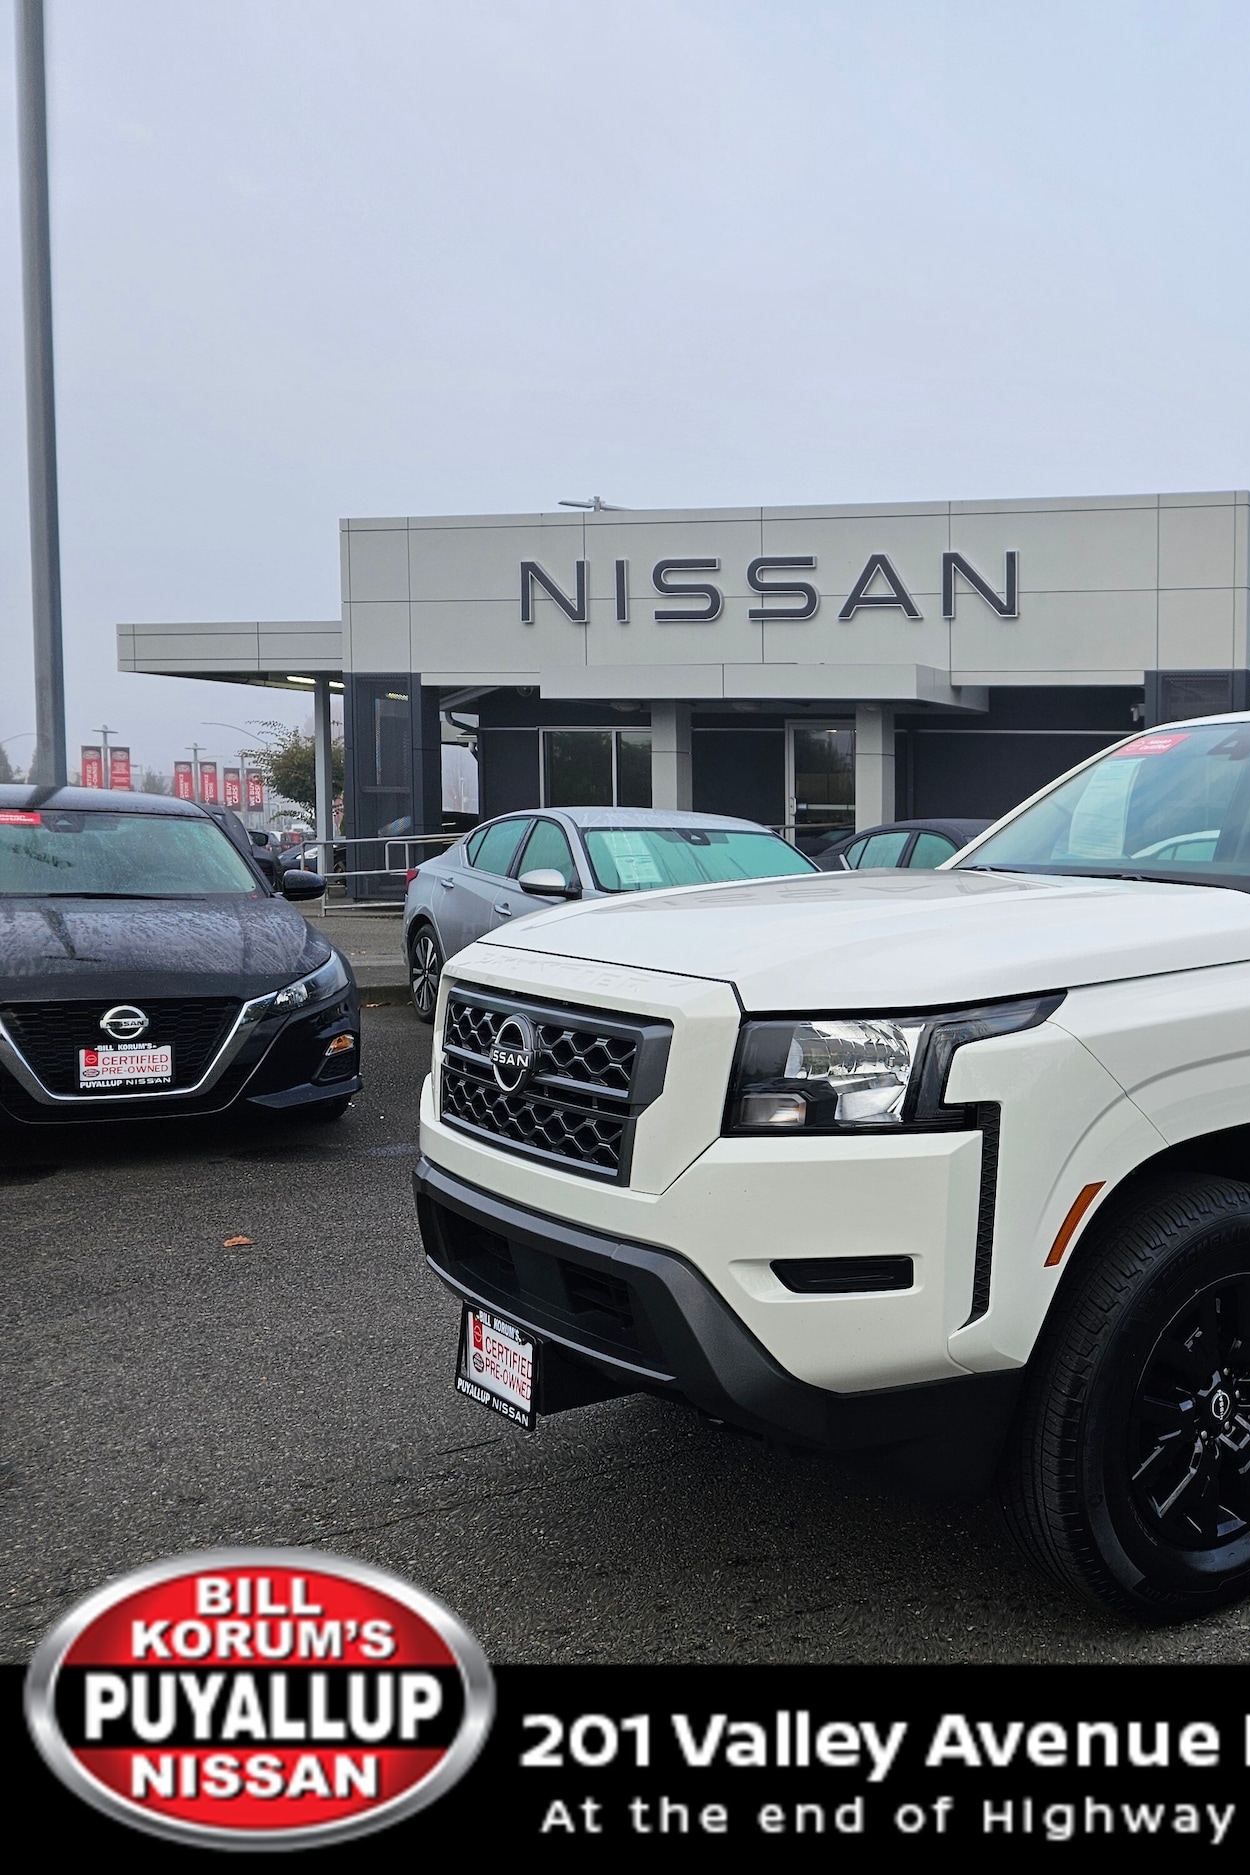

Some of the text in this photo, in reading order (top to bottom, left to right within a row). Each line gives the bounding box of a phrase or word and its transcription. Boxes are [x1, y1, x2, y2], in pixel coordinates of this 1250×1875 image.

[520, 550, 1019, 623] NISSAN
[226, 796, 232, 807] WE
[249, 796, 255, 807] WE
[102, 1054, 169, 1066] CERTIFIED
[492, 1049, 529, 1068] SSAN
[101, 1064, 169, 1075] PRE-OWNED
[80, 1077, 171, 1089] PUYALLUP NISSAN
[478, 1310, 491, 1327] BILL
[485, 1336, 533, 1380] CERTIFIED
[485, 1357, 532, 1400] PRE-OWNED
[457, 1377, 529, 1427] PUYALLUP NISSAN
